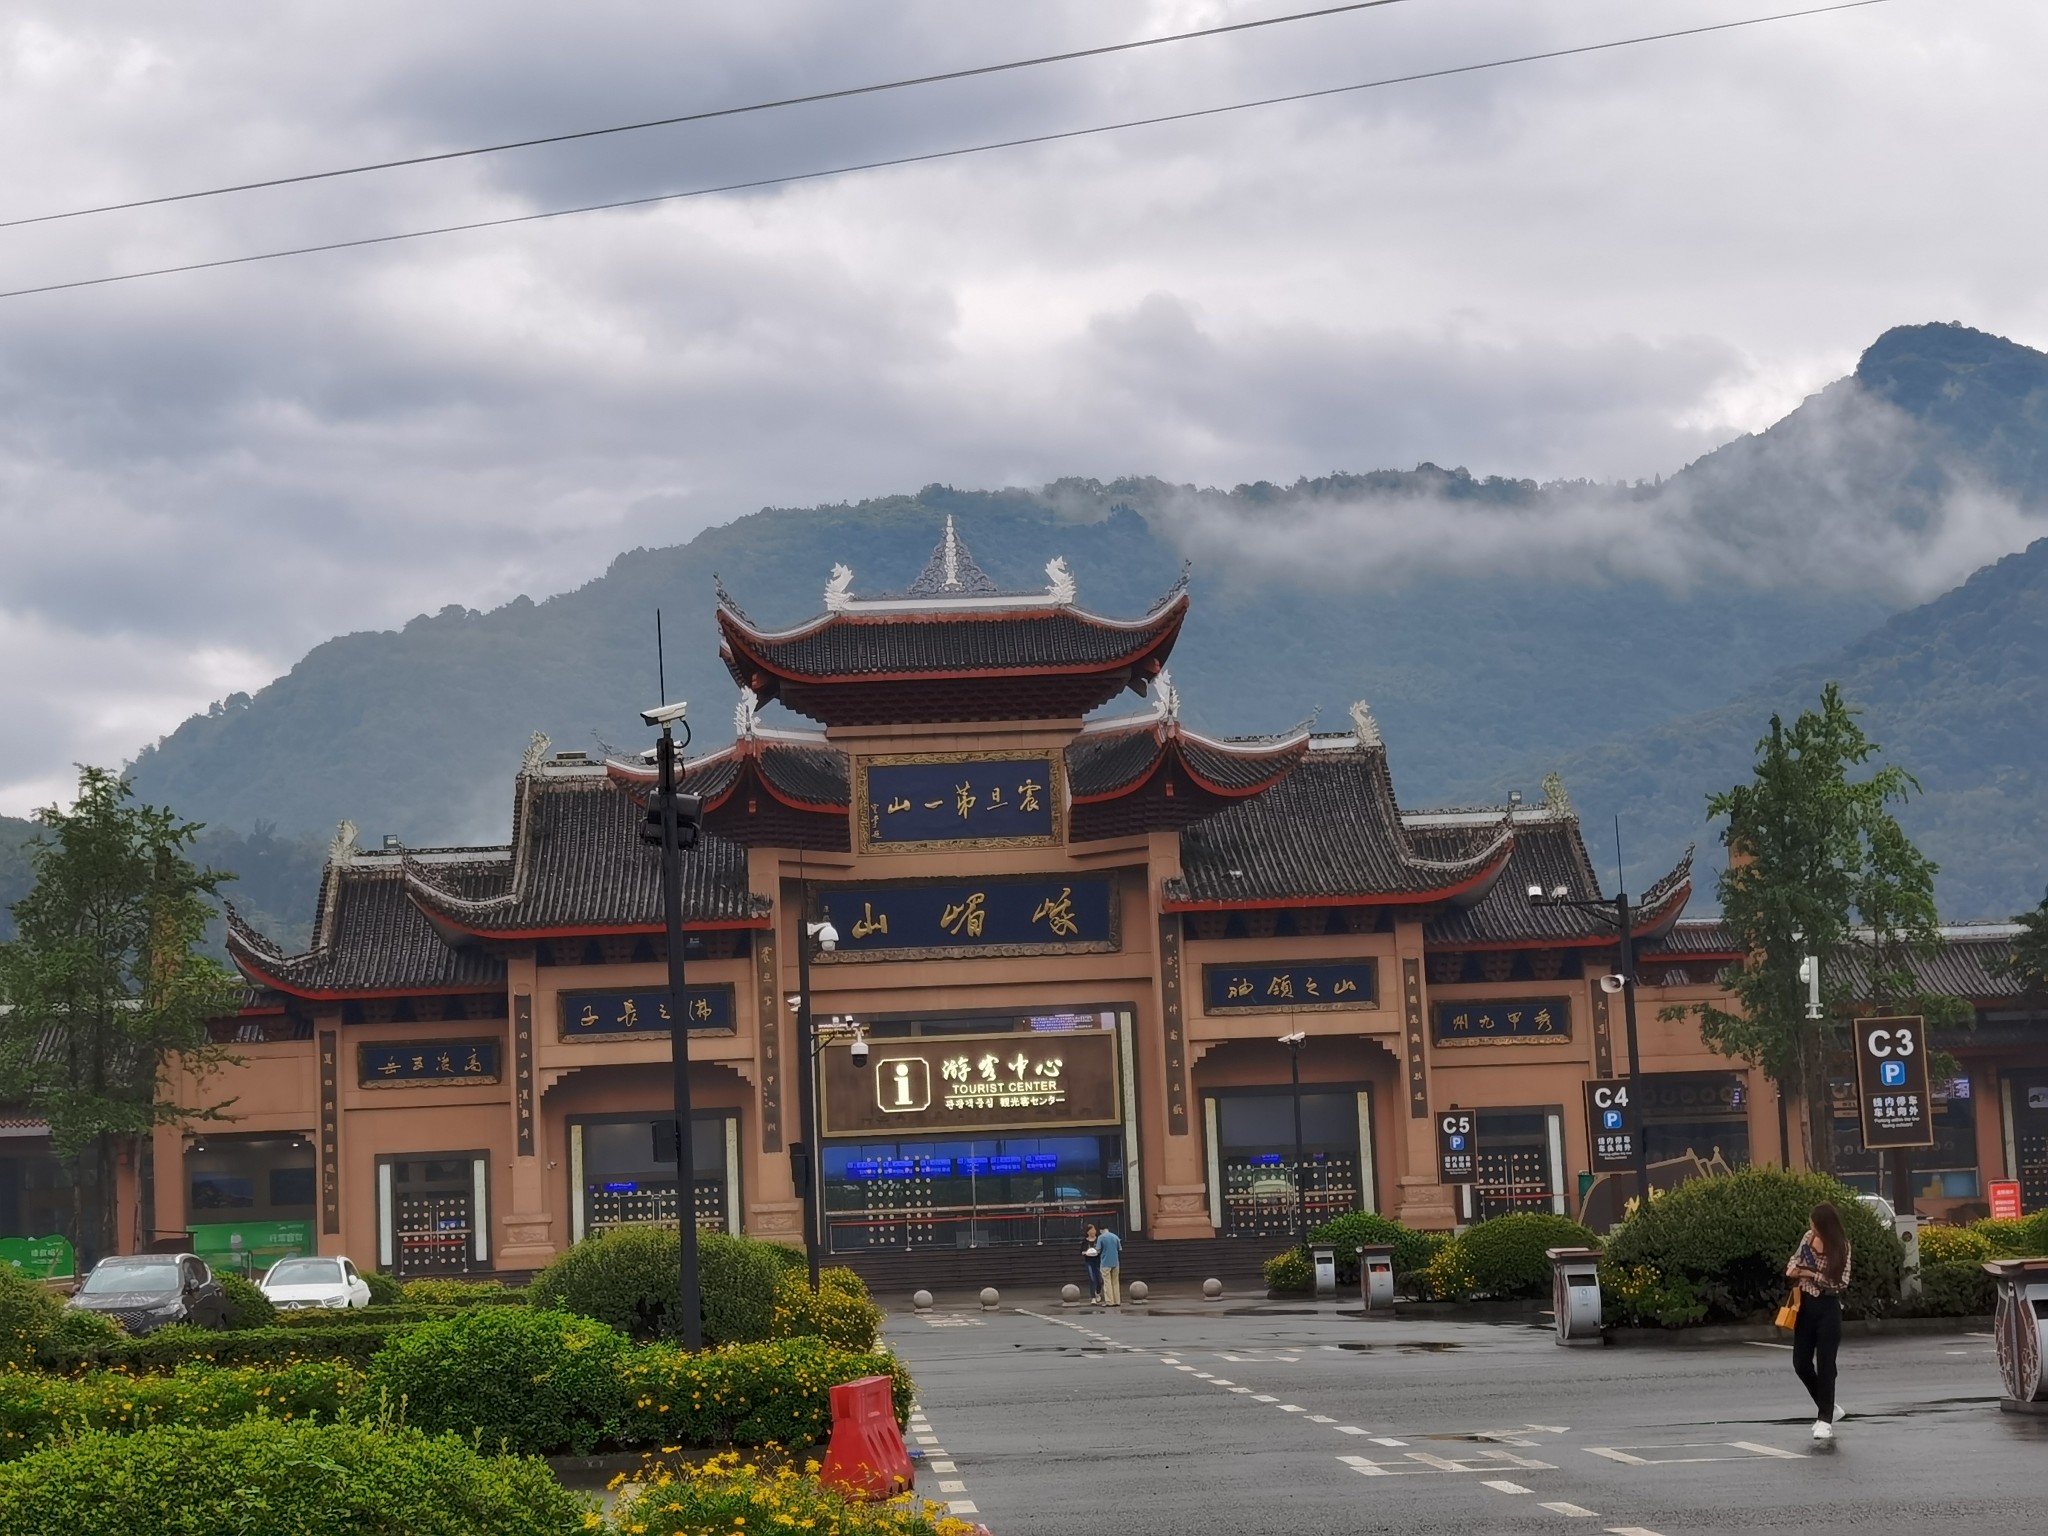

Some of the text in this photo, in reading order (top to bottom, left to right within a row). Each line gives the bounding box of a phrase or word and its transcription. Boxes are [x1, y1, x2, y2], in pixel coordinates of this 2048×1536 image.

[1868, 1028, 1914, 1057] C3
[941, 1053, 1063, 1082] 游客中心
[952, 1080, 1057, 1094] TOURIST CENTER
[1594, 1086, 1629, 1108] C4
[1442, 1116, 1470, 1134] C5
